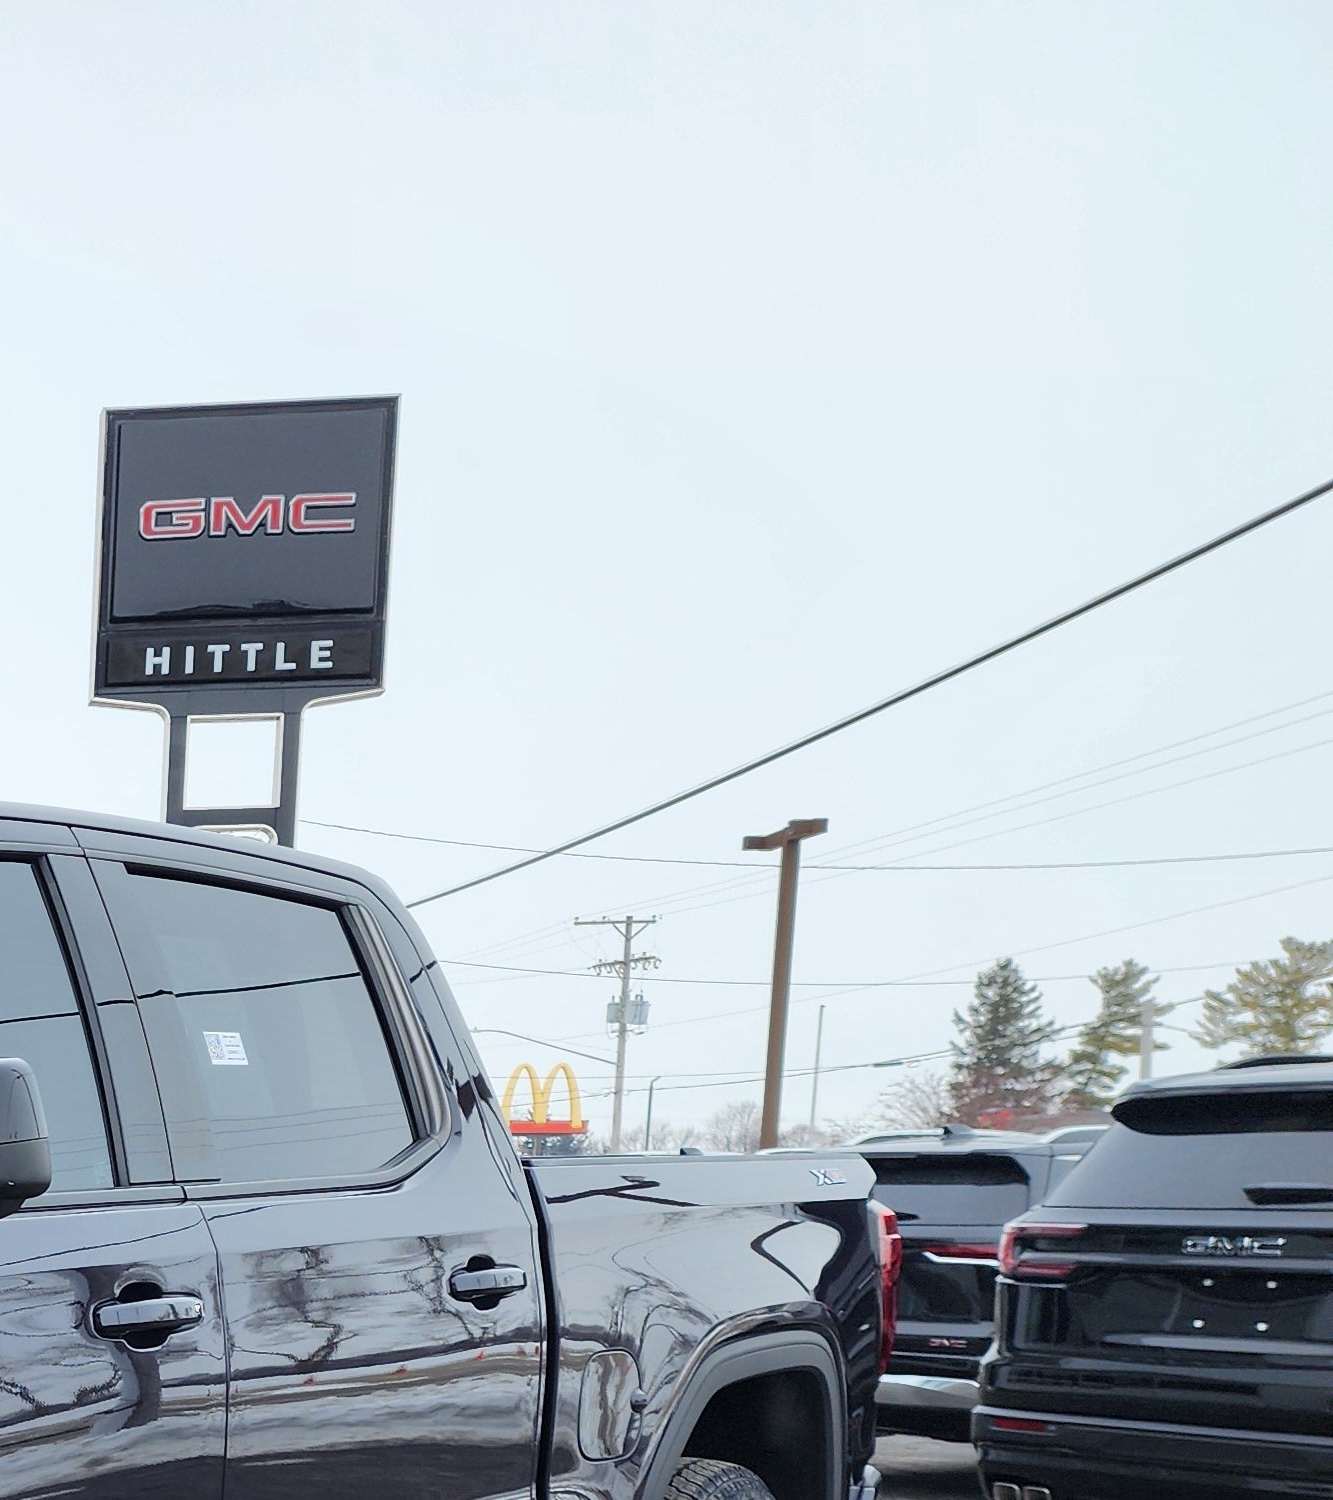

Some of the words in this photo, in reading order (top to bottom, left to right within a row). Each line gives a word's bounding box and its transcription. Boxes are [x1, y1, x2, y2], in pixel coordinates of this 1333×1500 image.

[138, 492, 356, 540] GMC
[144, 640, 334, 676] HITTLE
[1181, 1236, 1287, 1256] GMC
